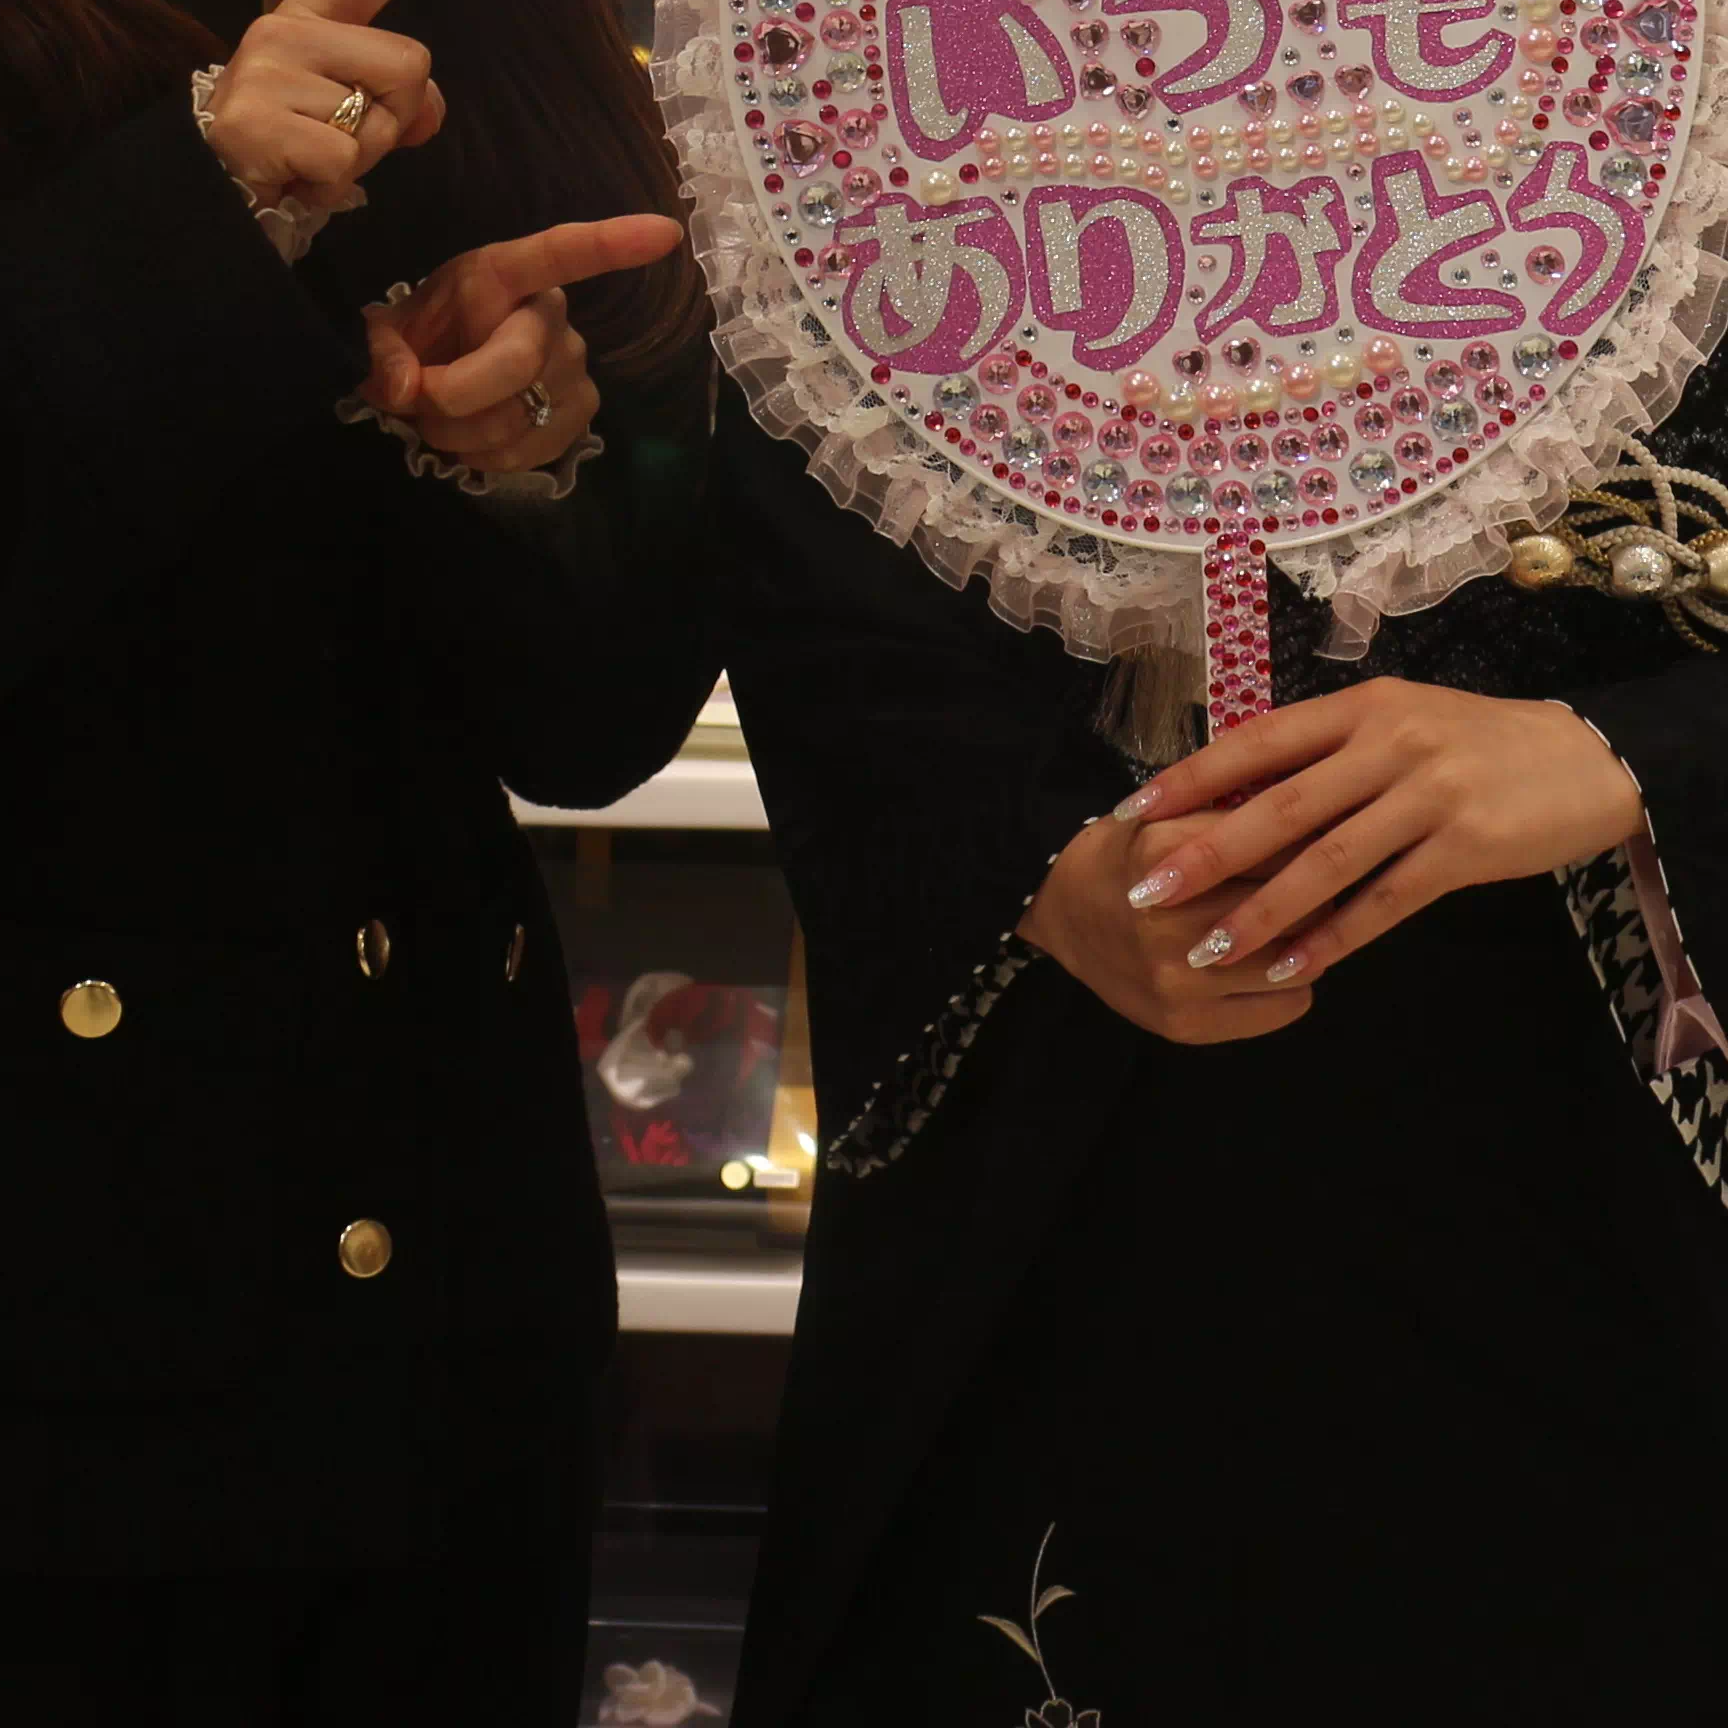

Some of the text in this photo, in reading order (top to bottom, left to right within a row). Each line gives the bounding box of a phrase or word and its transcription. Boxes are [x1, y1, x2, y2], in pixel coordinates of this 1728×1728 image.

[832, 141, 1646, 375] ありがとう
